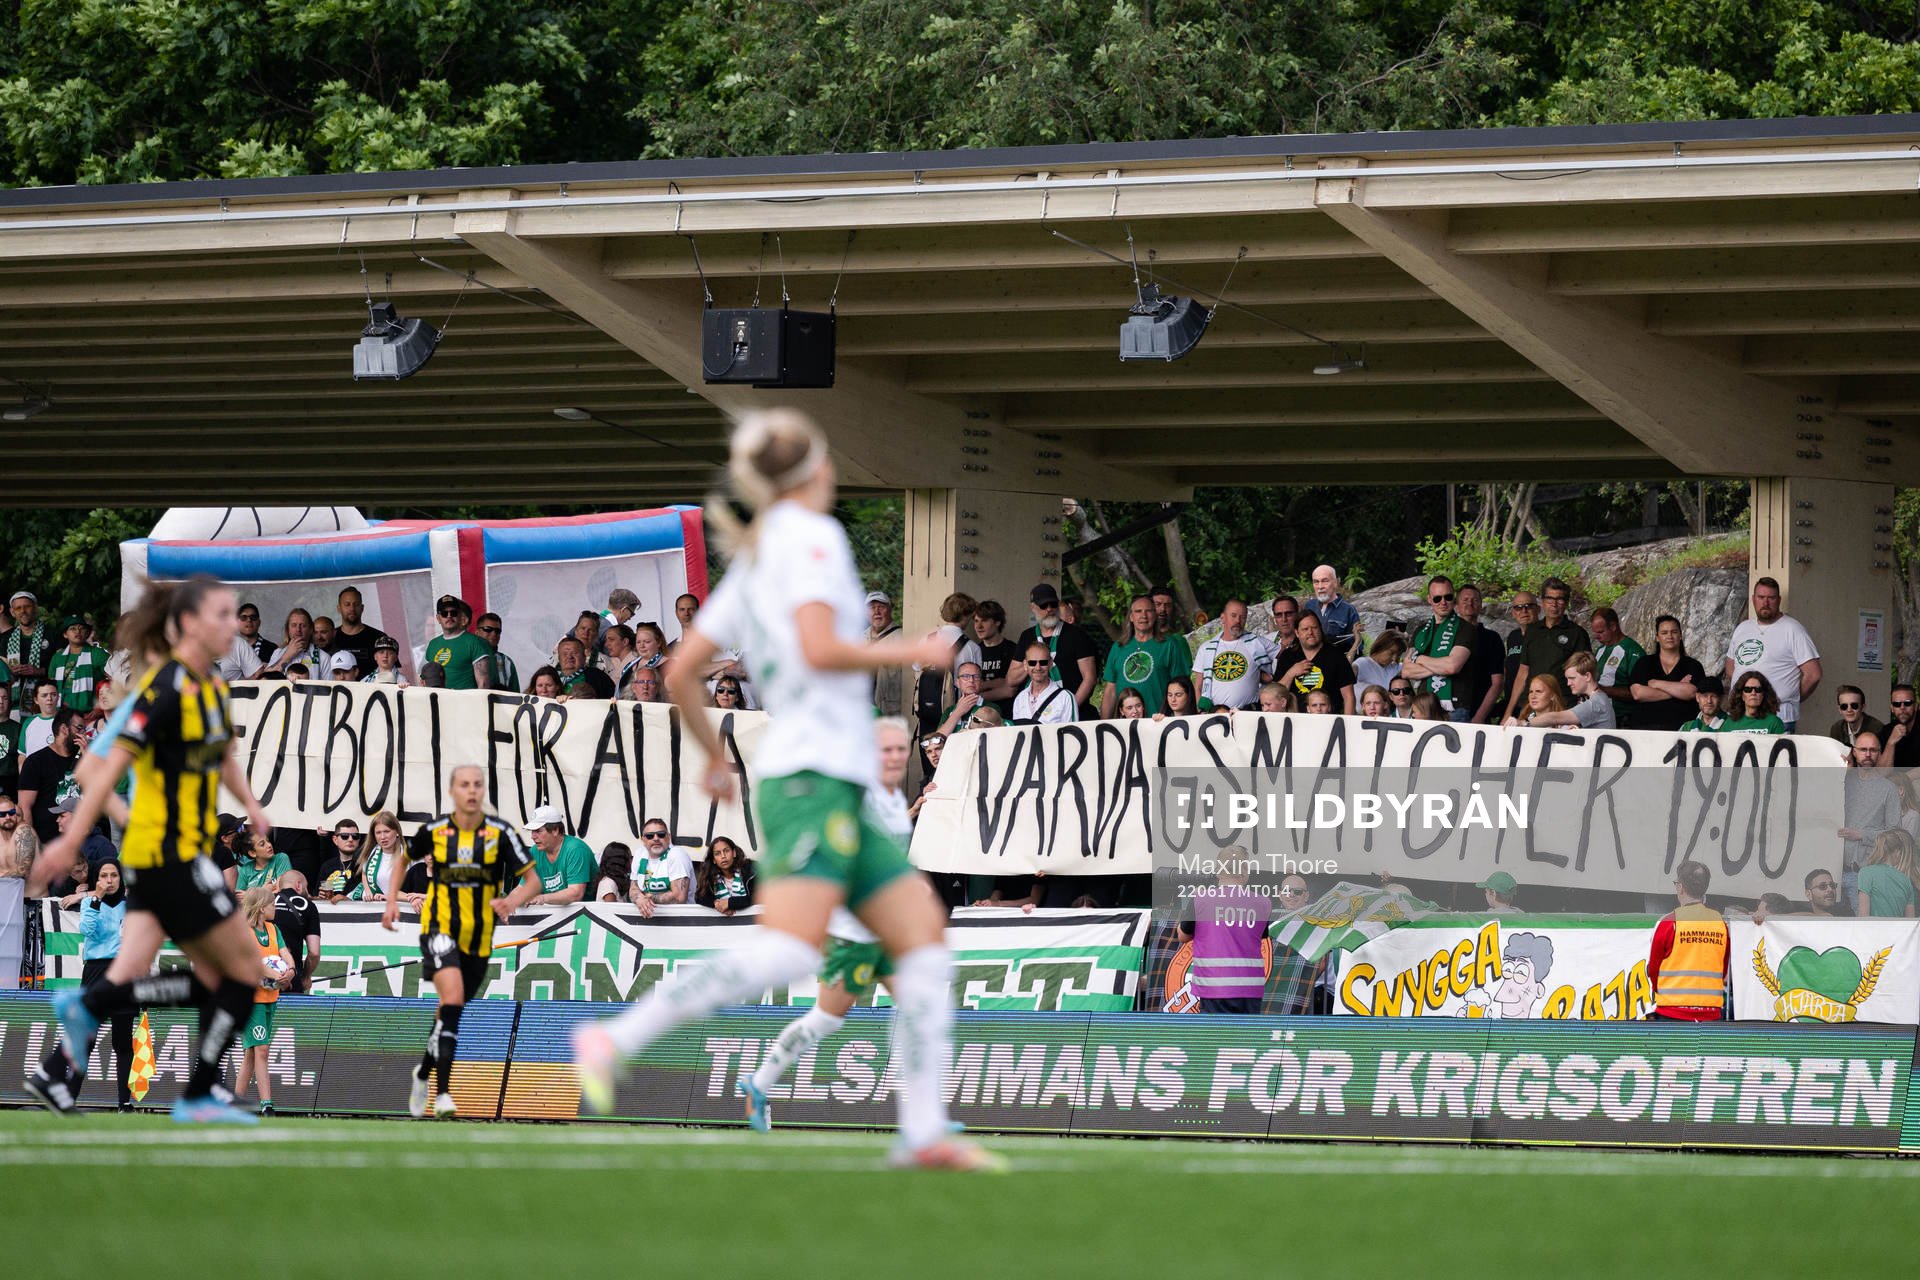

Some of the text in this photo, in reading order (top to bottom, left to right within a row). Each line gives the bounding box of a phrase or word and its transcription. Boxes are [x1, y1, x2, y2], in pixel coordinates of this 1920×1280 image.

[488, 694, 576, 836] FÖR
[577, 703, 757, 851] ALLA
[977, 714, 1799, 879] VARDAGSMATCHER 19:00
[1215, 906, 1257, 929] FOTO
[1680, 930, 1724, 938] HAMMARBY
[1680, 937, 1724, 946] PERSONAL
[1341, 922, 1503, 1017] SNYGGA
[1207, 1030, 1355, 1115] FÖR
[1371, 1050, 1898, 1127] KRIGSOFFREN
